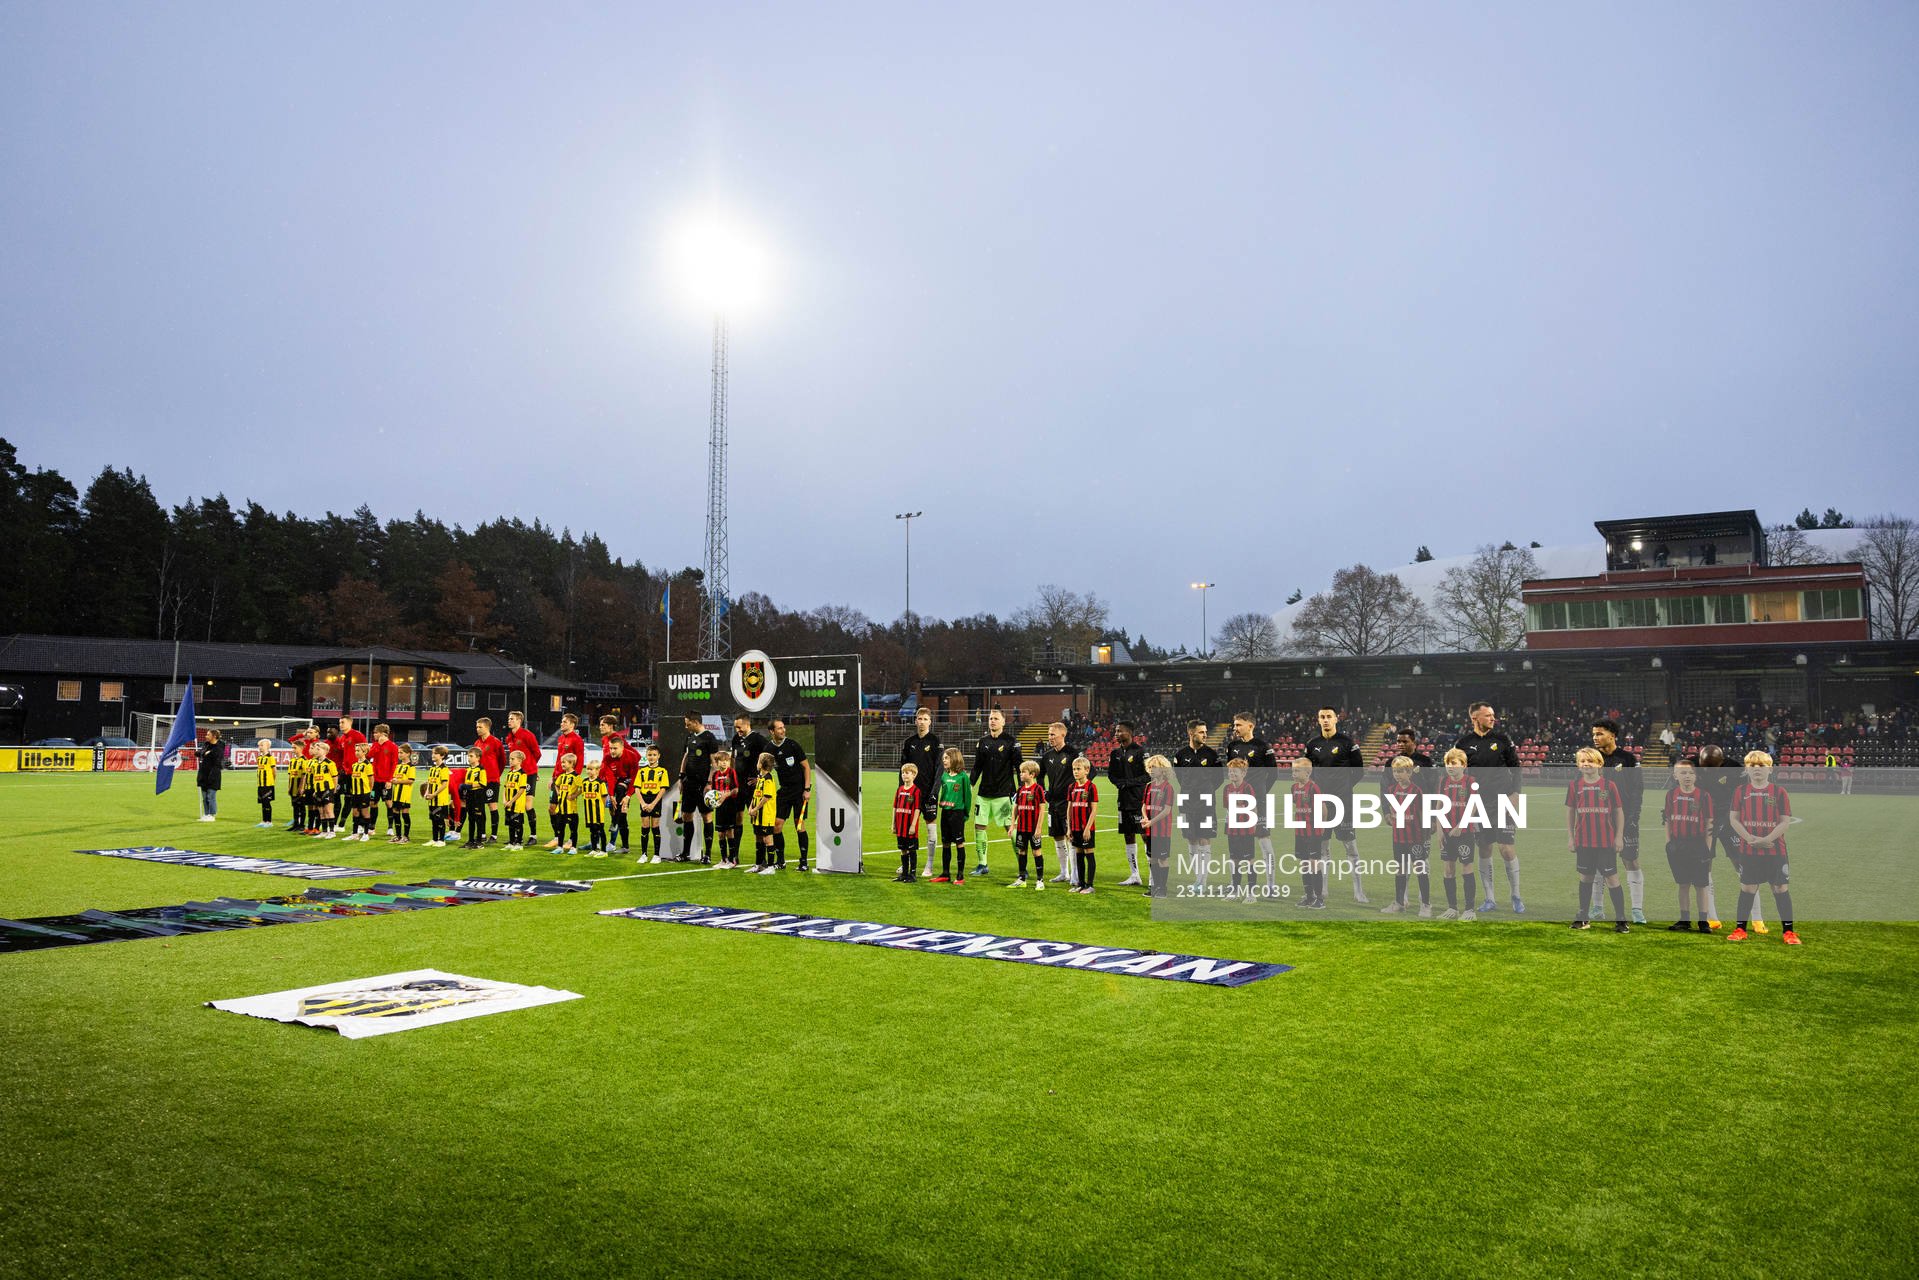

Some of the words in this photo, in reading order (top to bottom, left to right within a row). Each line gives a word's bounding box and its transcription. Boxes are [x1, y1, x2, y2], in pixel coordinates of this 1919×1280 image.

[668, 673, 720, 690] UNIBET
[788, 669, 847, 687] UNIBET
[236, 752, 293, 764] BAHA
[830, 808, 845, 833] U
[682, 912, 1255, 980] ALLSVENSKAN
